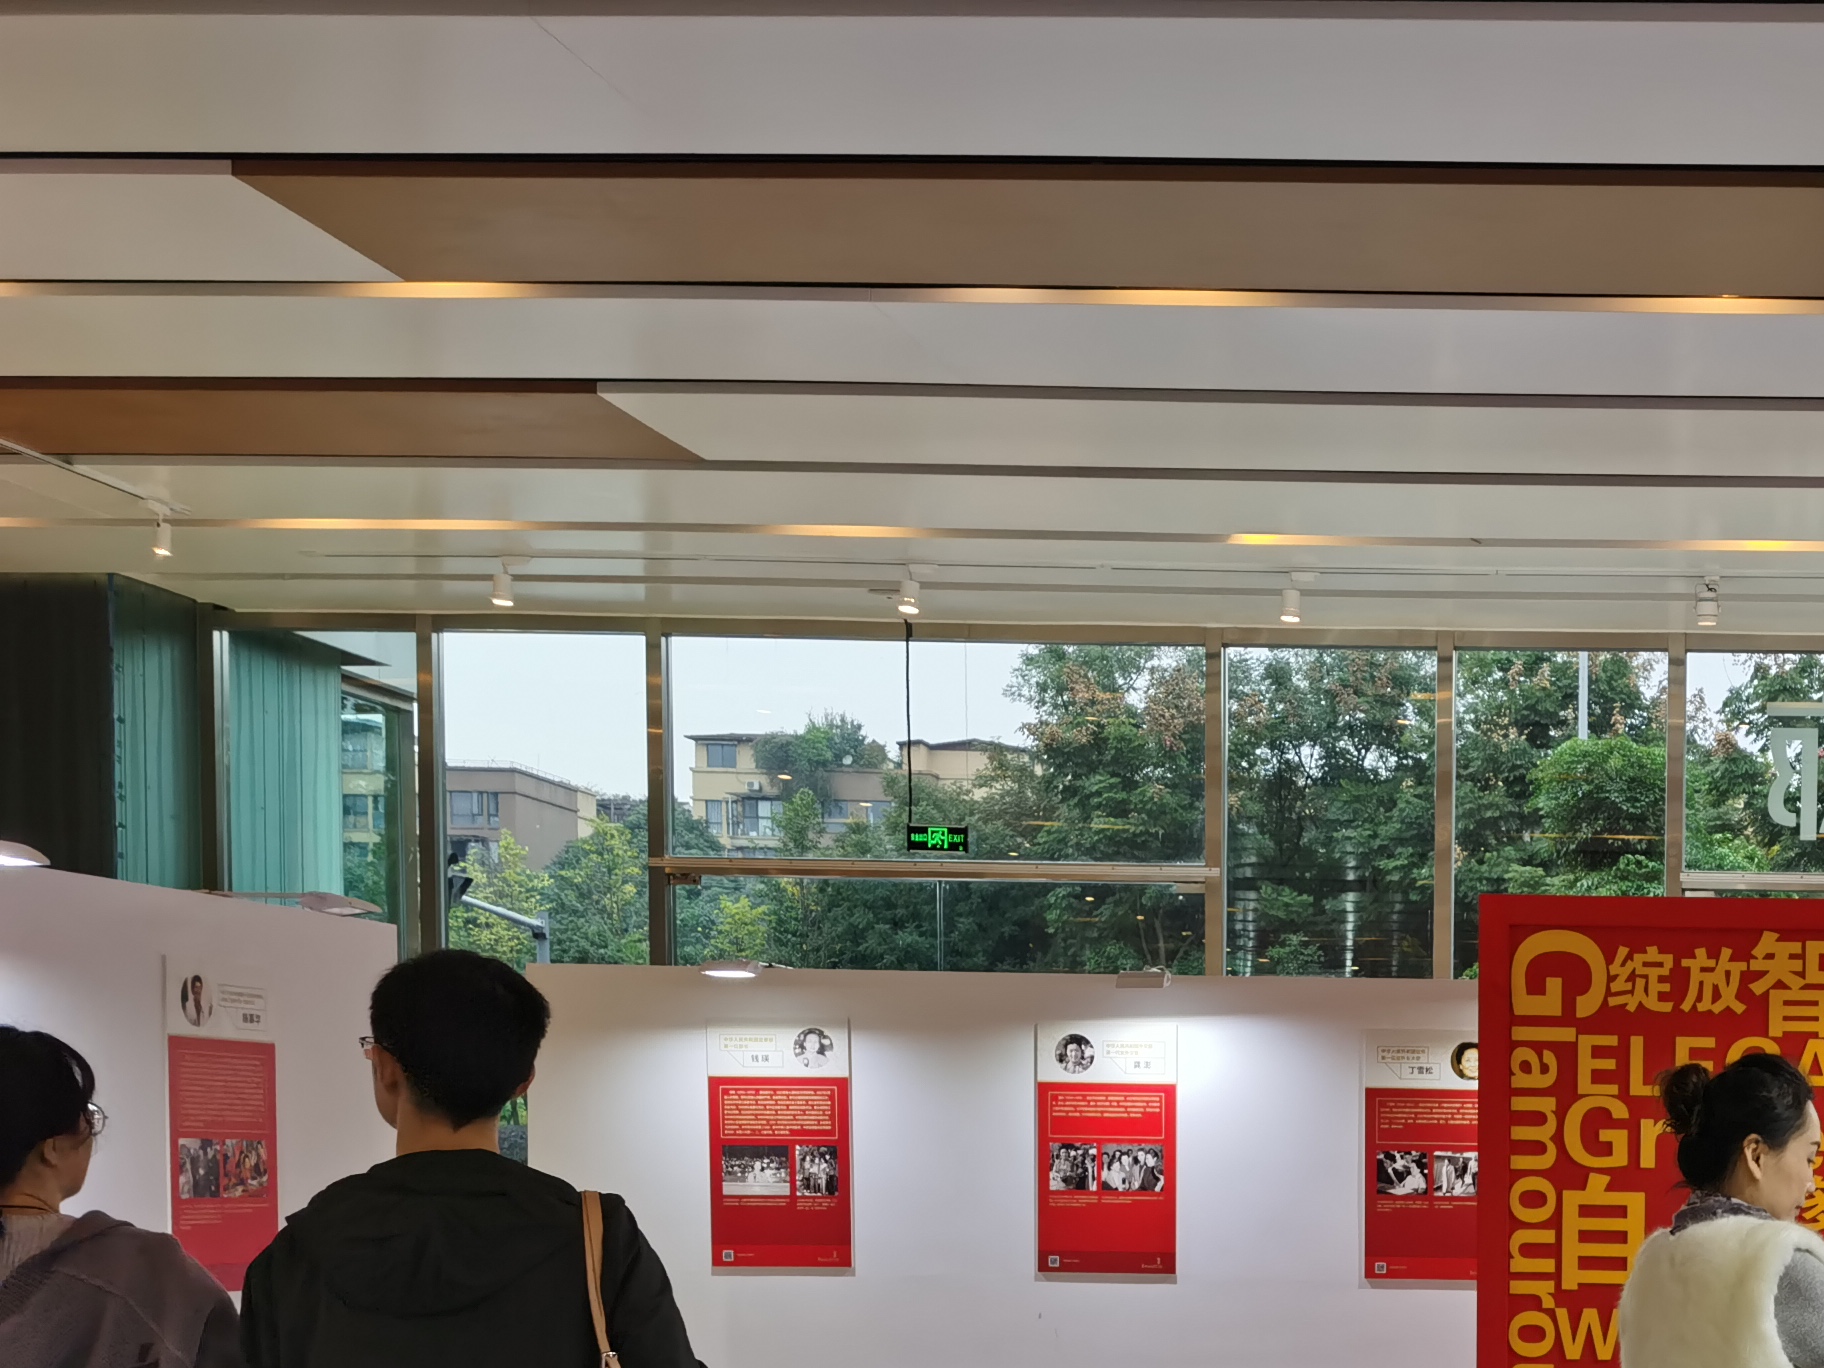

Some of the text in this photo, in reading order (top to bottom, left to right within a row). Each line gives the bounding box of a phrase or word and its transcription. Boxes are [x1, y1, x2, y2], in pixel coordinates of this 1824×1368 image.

[948, 834, 965, 843] EXIT
[1408, 1066, 1434, 1075] 丁雪松
